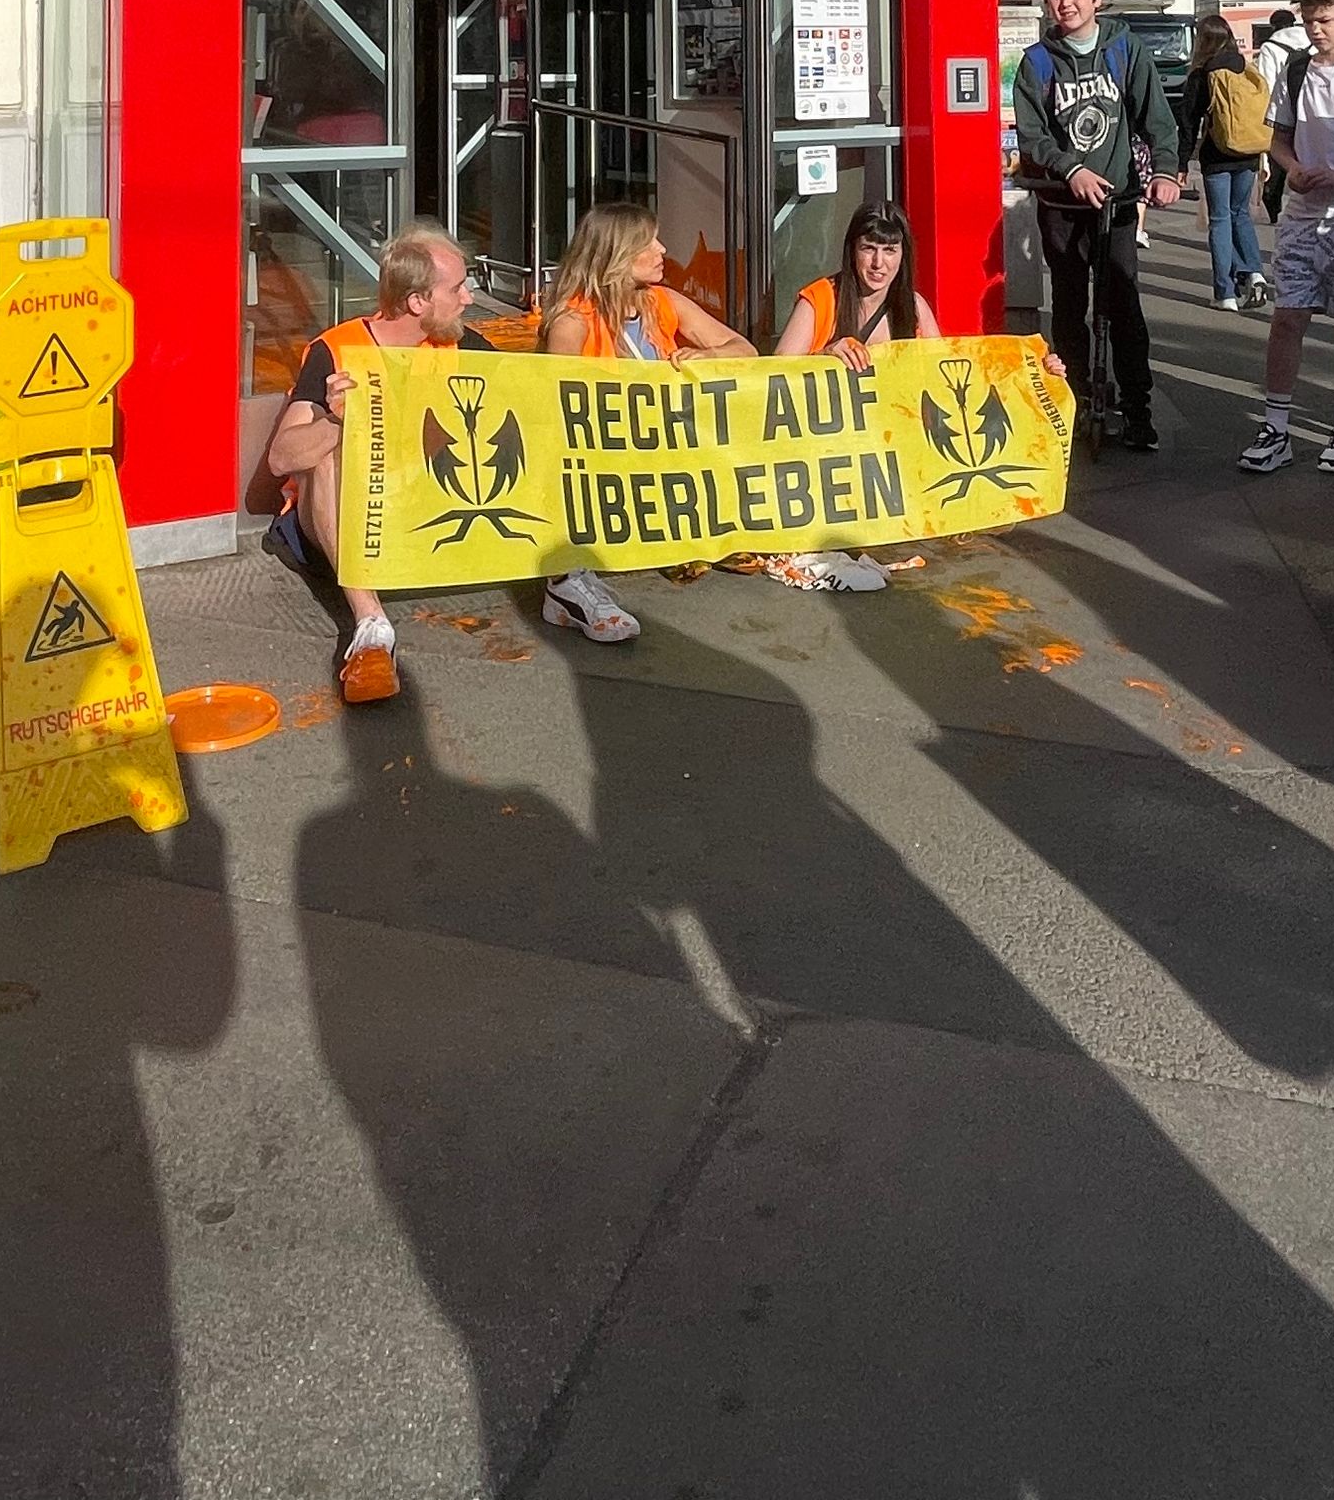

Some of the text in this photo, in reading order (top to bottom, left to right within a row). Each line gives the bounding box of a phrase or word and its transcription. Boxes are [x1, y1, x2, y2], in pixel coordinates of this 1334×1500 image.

[7, 289, 100, 318] ACHTUNG
[559, 364, 878, 450] RECHT AUF
[1025, 353, 1068, 438] GENERATION.AT
[364, 370, 386, 559] LETZTE GENERATION.AT
[561, 450, 906, 546] ÜBERLEBEN
[9, 691, 150, 745] RUTSCHGEFAHR
